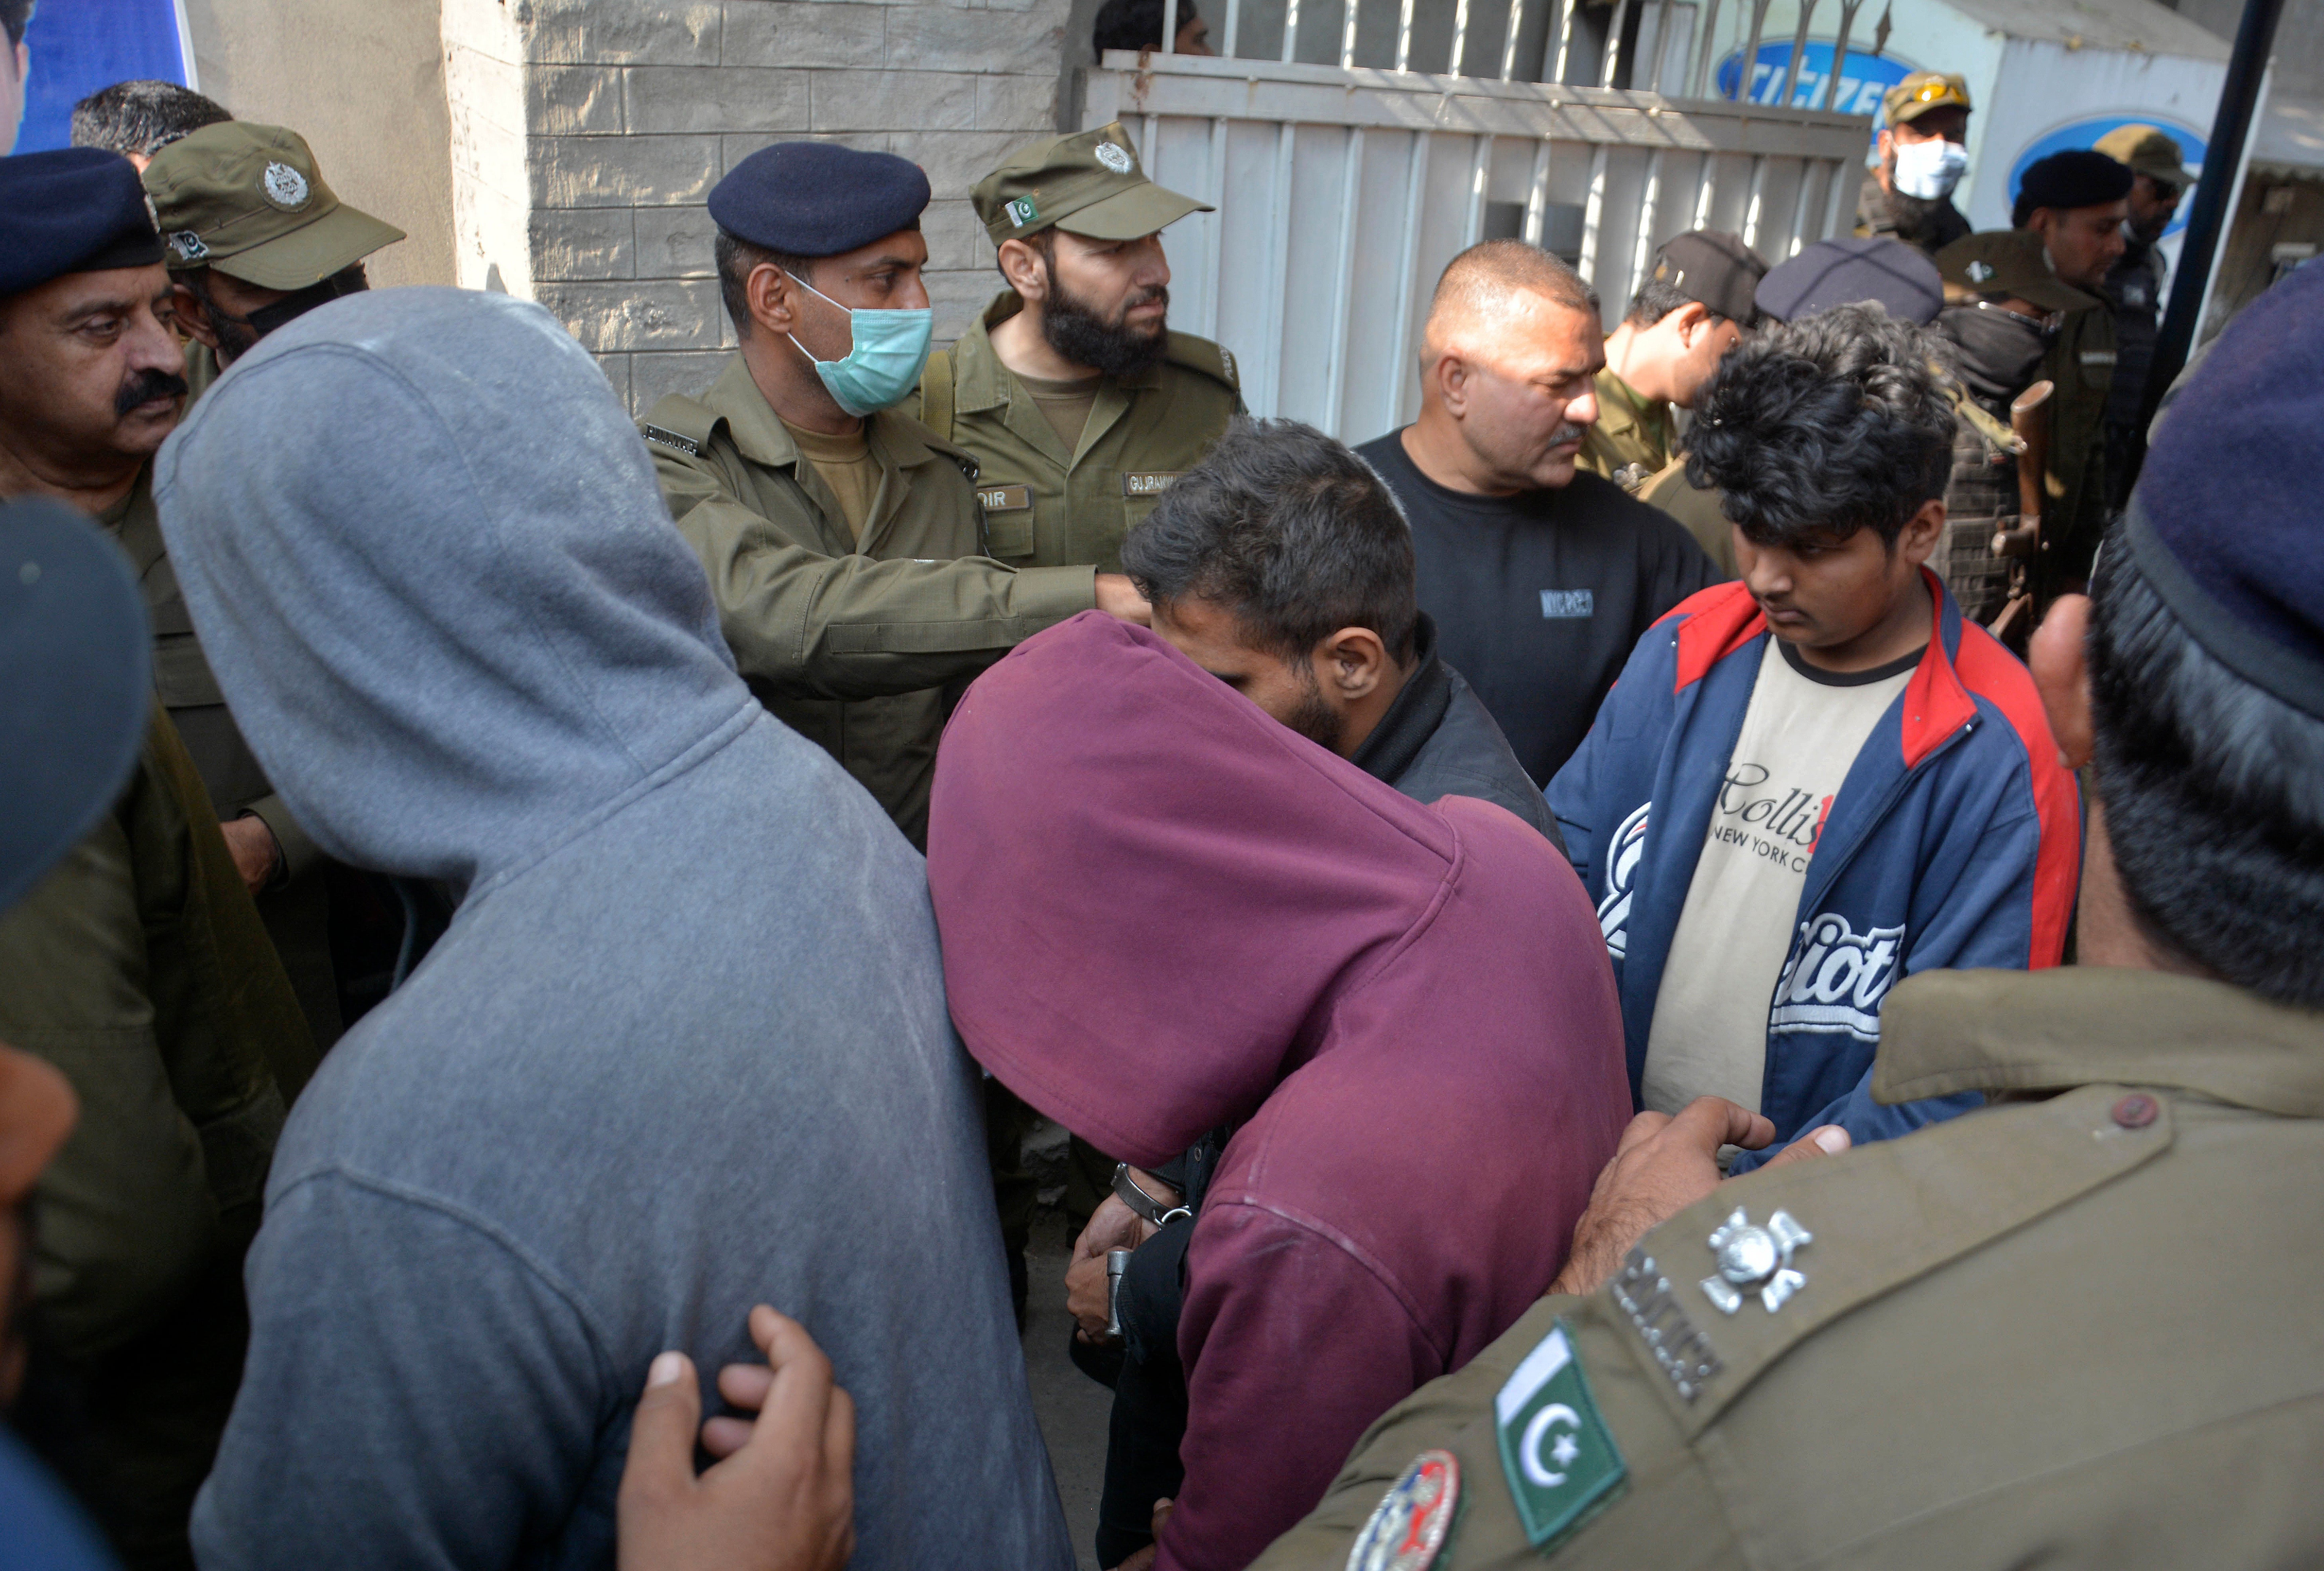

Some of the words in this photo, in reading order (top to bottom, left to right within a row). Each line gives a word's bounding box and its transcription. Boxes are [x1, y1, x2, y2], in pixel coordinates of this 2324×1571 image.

[1715, 825, 1749, 846] NEW
[1753, 836, 1789, 866] YORK
[1792, 857, 1811, 876] C
